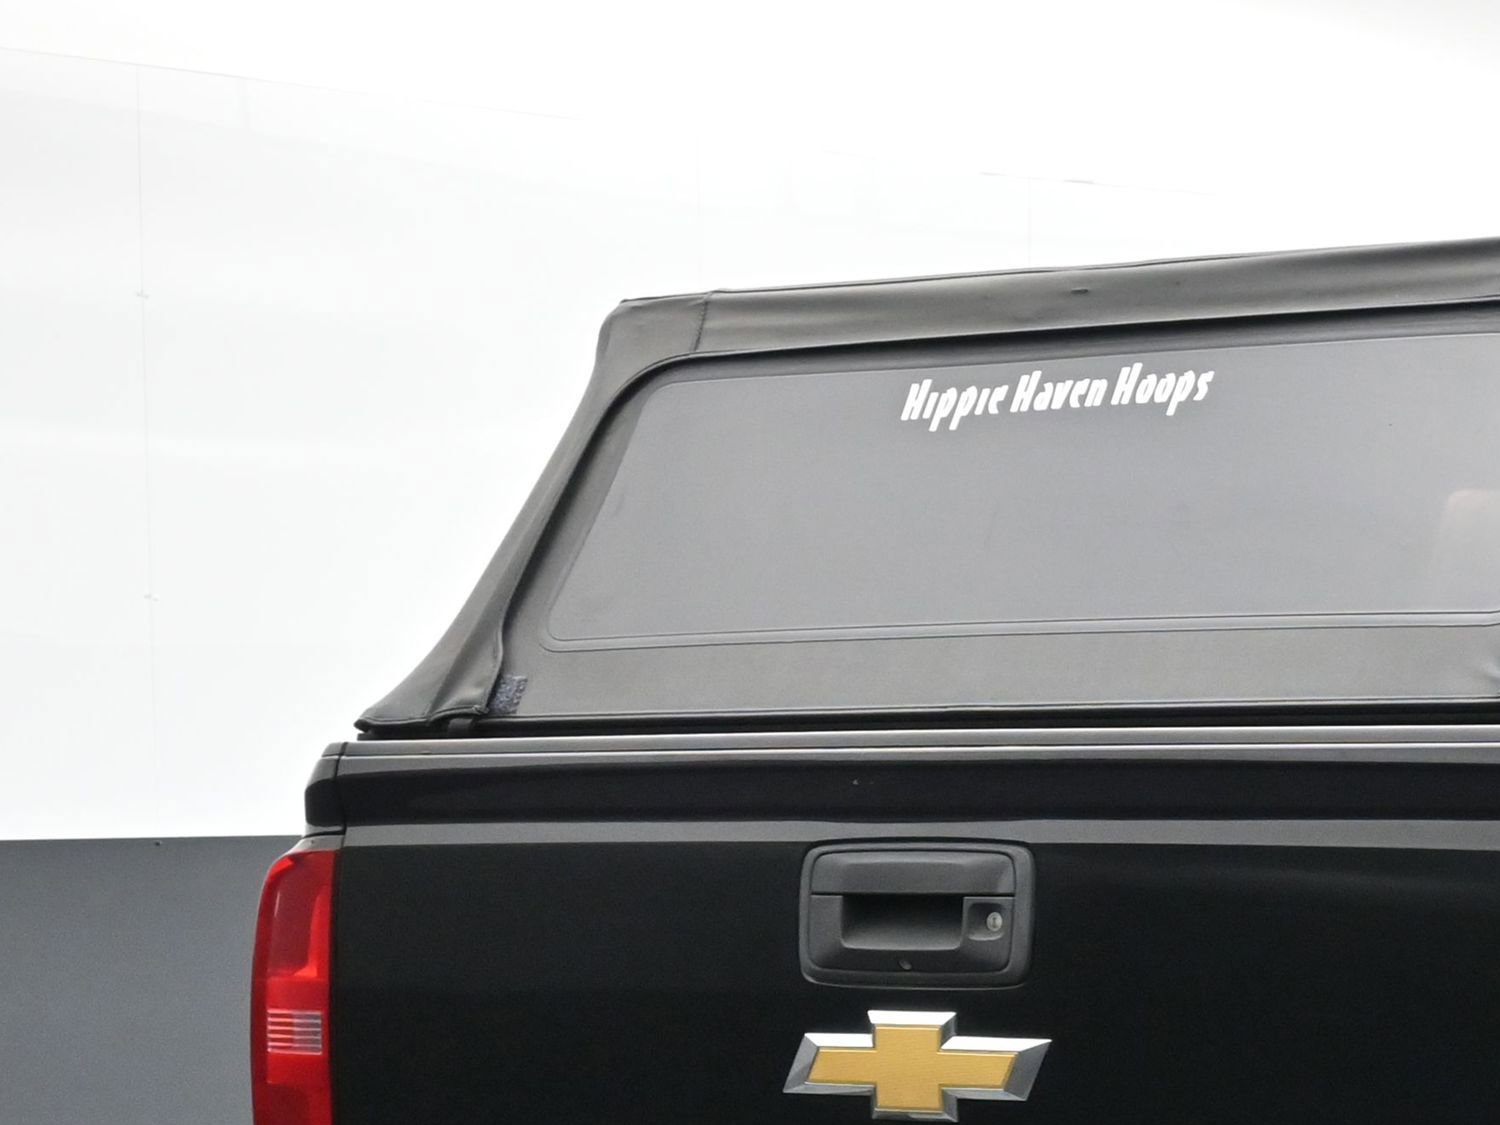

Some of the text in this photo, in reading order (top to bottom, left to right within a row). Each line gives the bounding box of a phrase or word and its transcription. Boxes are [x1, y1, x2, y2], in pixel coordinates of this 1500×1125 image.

[900, 362, 1215, 432] Hippie Haven Hoops
